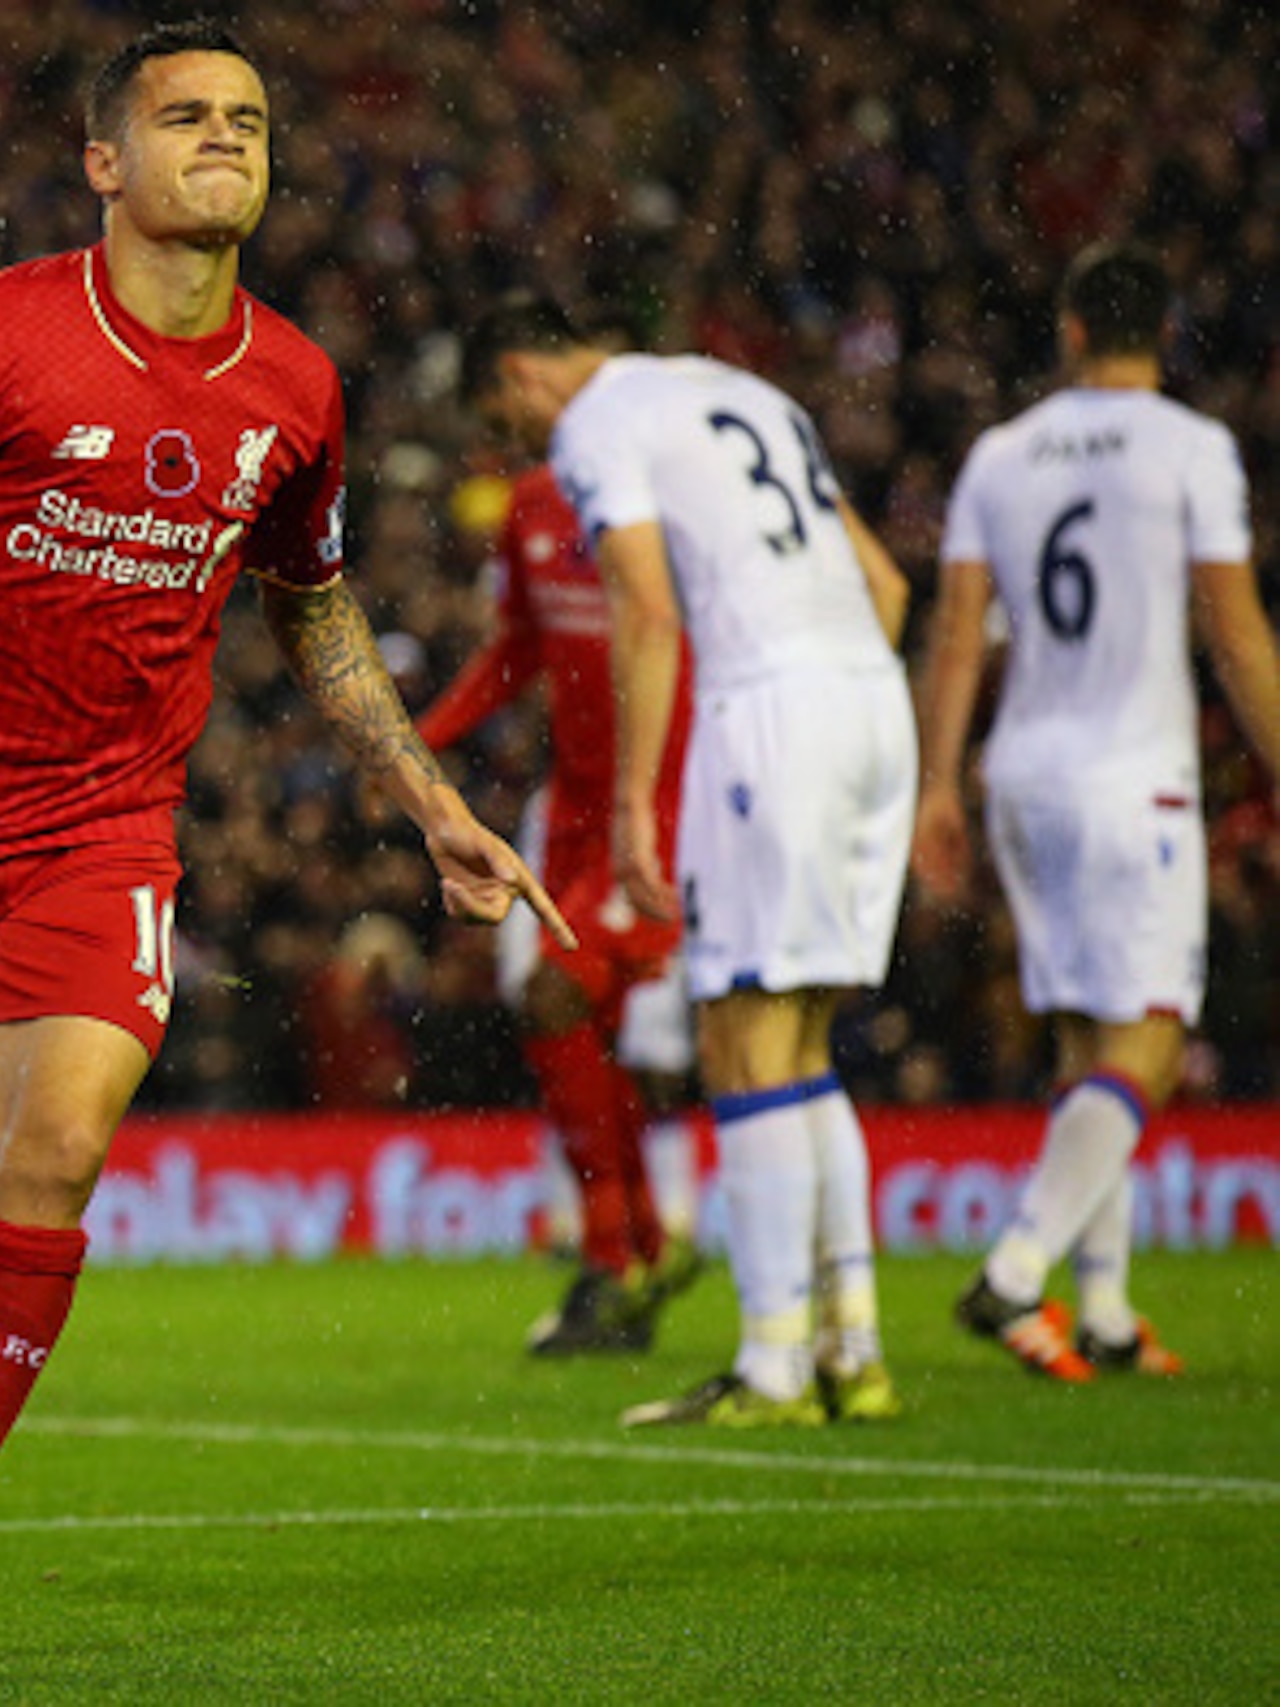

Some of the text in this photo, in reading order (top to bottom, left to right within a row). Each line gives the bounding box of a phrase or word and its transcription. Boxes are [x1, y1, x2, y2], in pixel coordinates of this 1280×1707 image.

[36, 488, 212, 555] Standard
[6, 523, 195, 588] Chartered
[1038, 498, 1096, 643] 6
